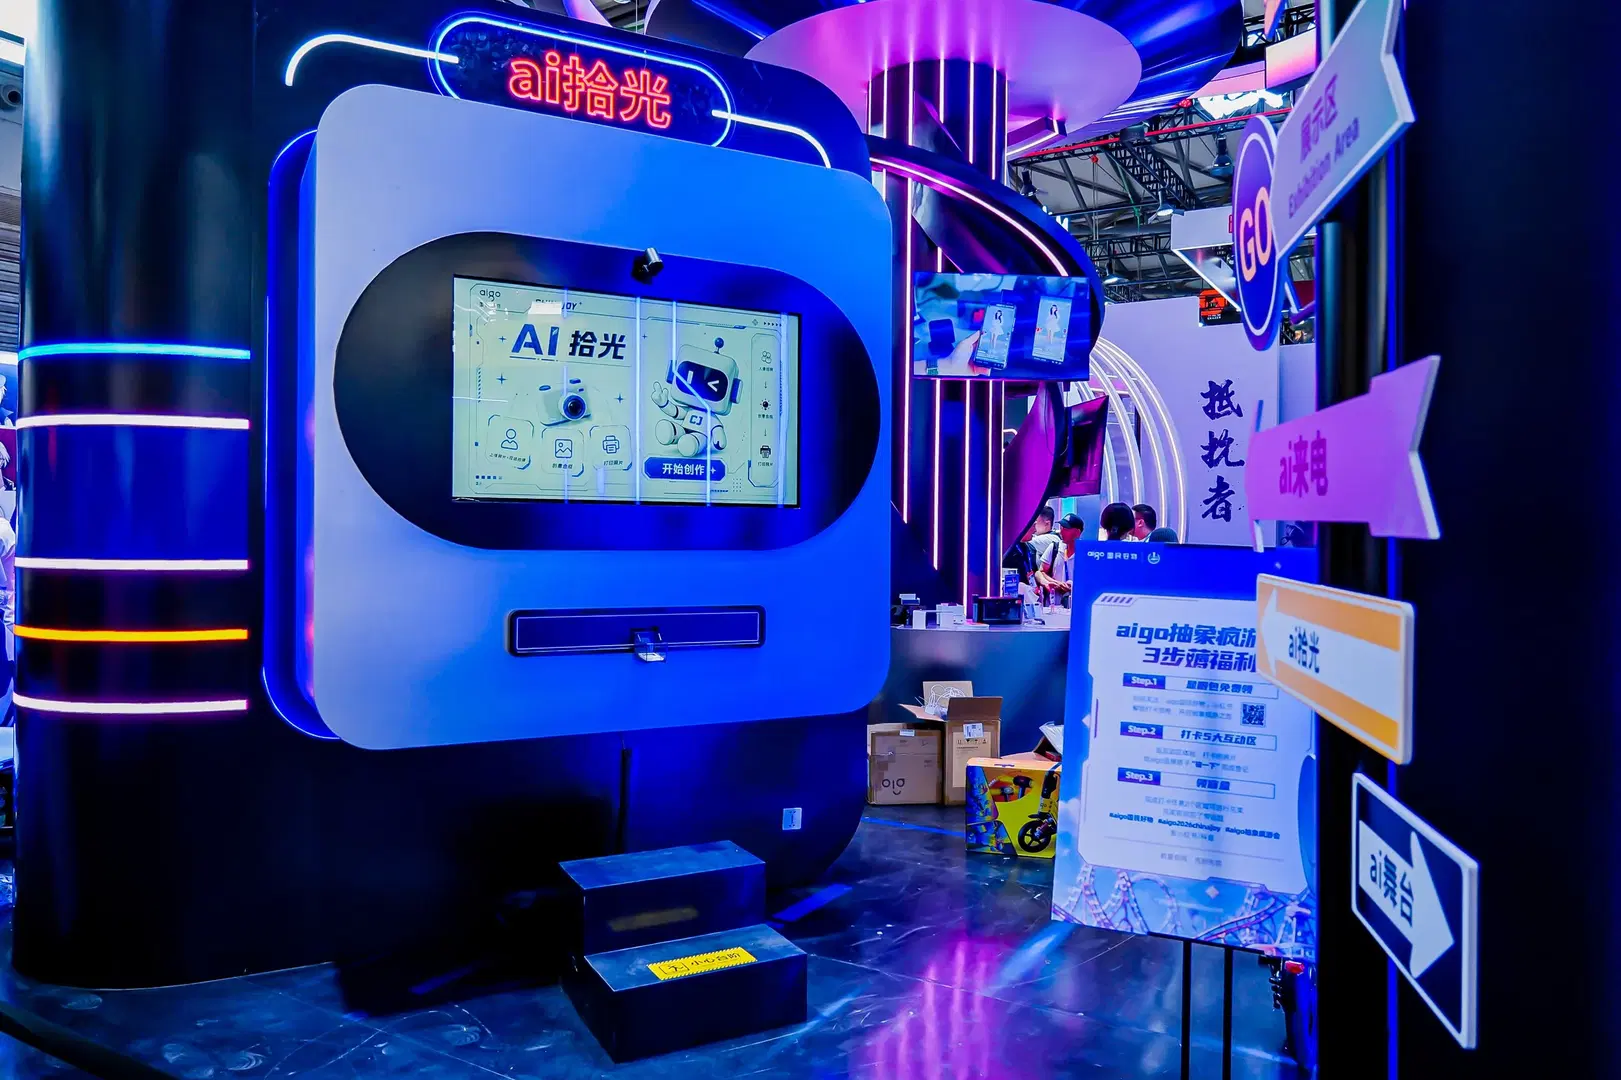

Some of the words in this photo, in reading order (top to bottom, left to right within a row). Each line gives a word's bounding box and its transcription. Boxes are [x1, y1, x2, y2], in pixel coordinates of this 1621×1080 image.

[509, 51, 672, 129] ai拾光
[1301, 73, 1338, 163] 展示区
[1334, 117, 1360, 162] Area
[1240, 186, 1272, 281] GO
[479, 289, 501, 302] aigo
[511, 323, 560, 356] AI
[568, 330, 626, 361] 拾光
[662, 462, 705, 475] 开始创作
[1279, 429, 1328, 498] ai来电
[1289, 626, 1319, 674] ai拾光
[1131, 676, 1157, 687] Step.1
[1128, 724, 1156, 736] Step.2
[1180, 729, 1257, 746] 打卡5大互动区
[1125, 771, 1153, 782] Step.3
[1370, 849, 1414, 928] ai舞台
[690, 953, 741, 966] 小心台阶
